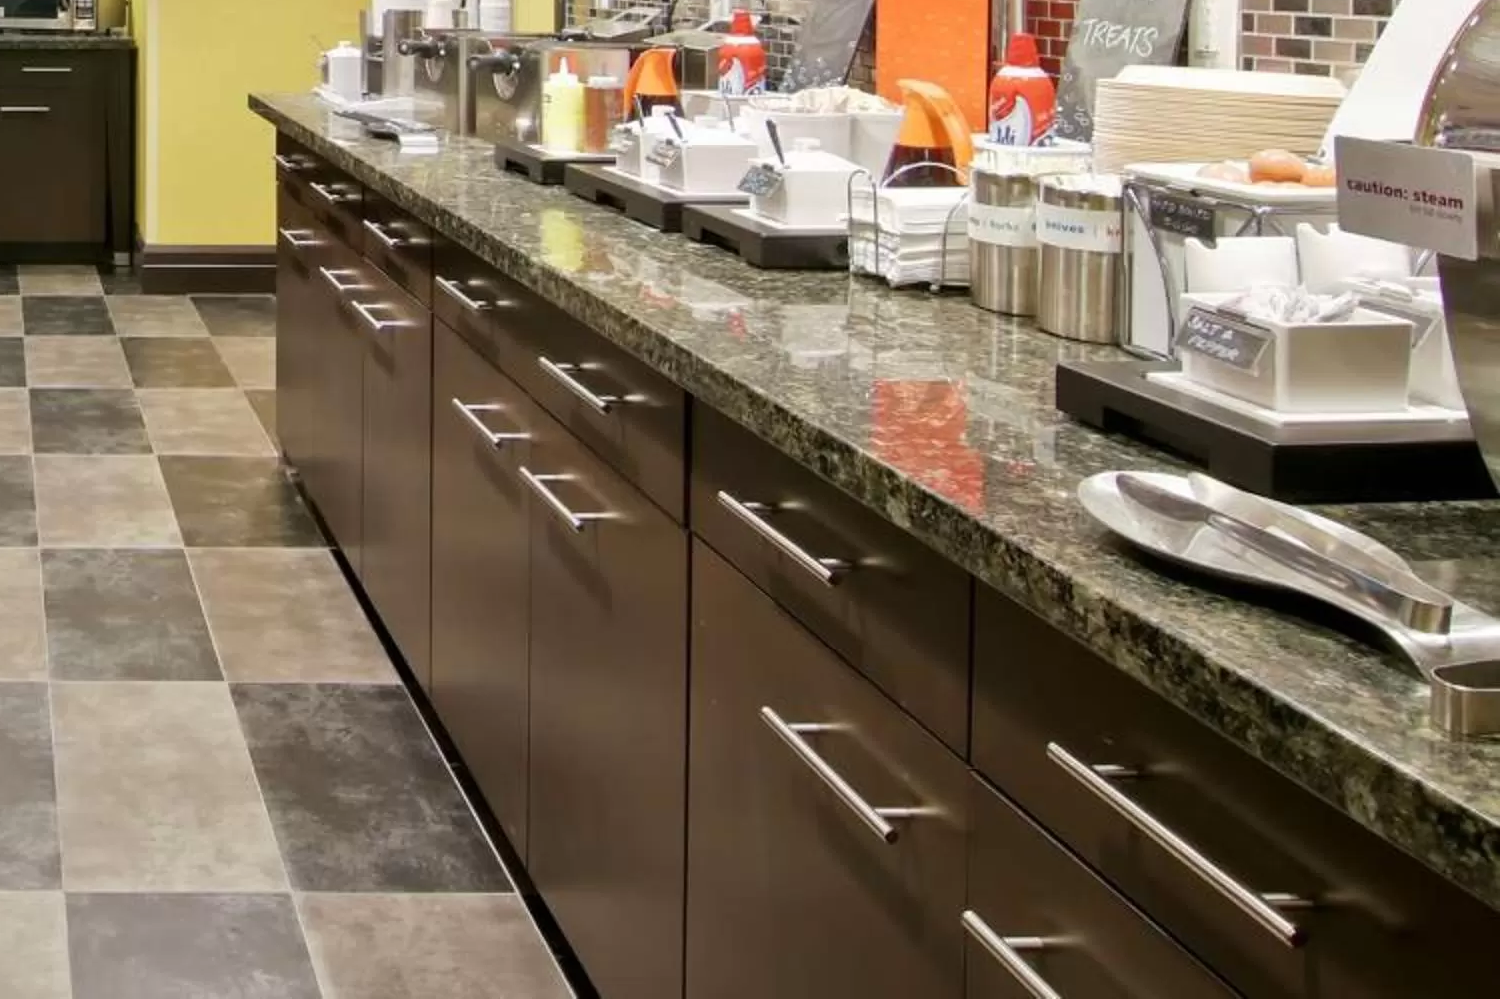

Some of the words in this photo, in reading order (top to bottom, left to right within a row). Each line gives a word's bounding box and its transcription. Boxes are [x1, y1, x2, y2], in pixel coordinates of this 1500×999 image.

[1082, 18, 1160, 58] TREATS
[1346, 178, 1409, 200] caution:
[1412, 188, 1464, 210] steam
